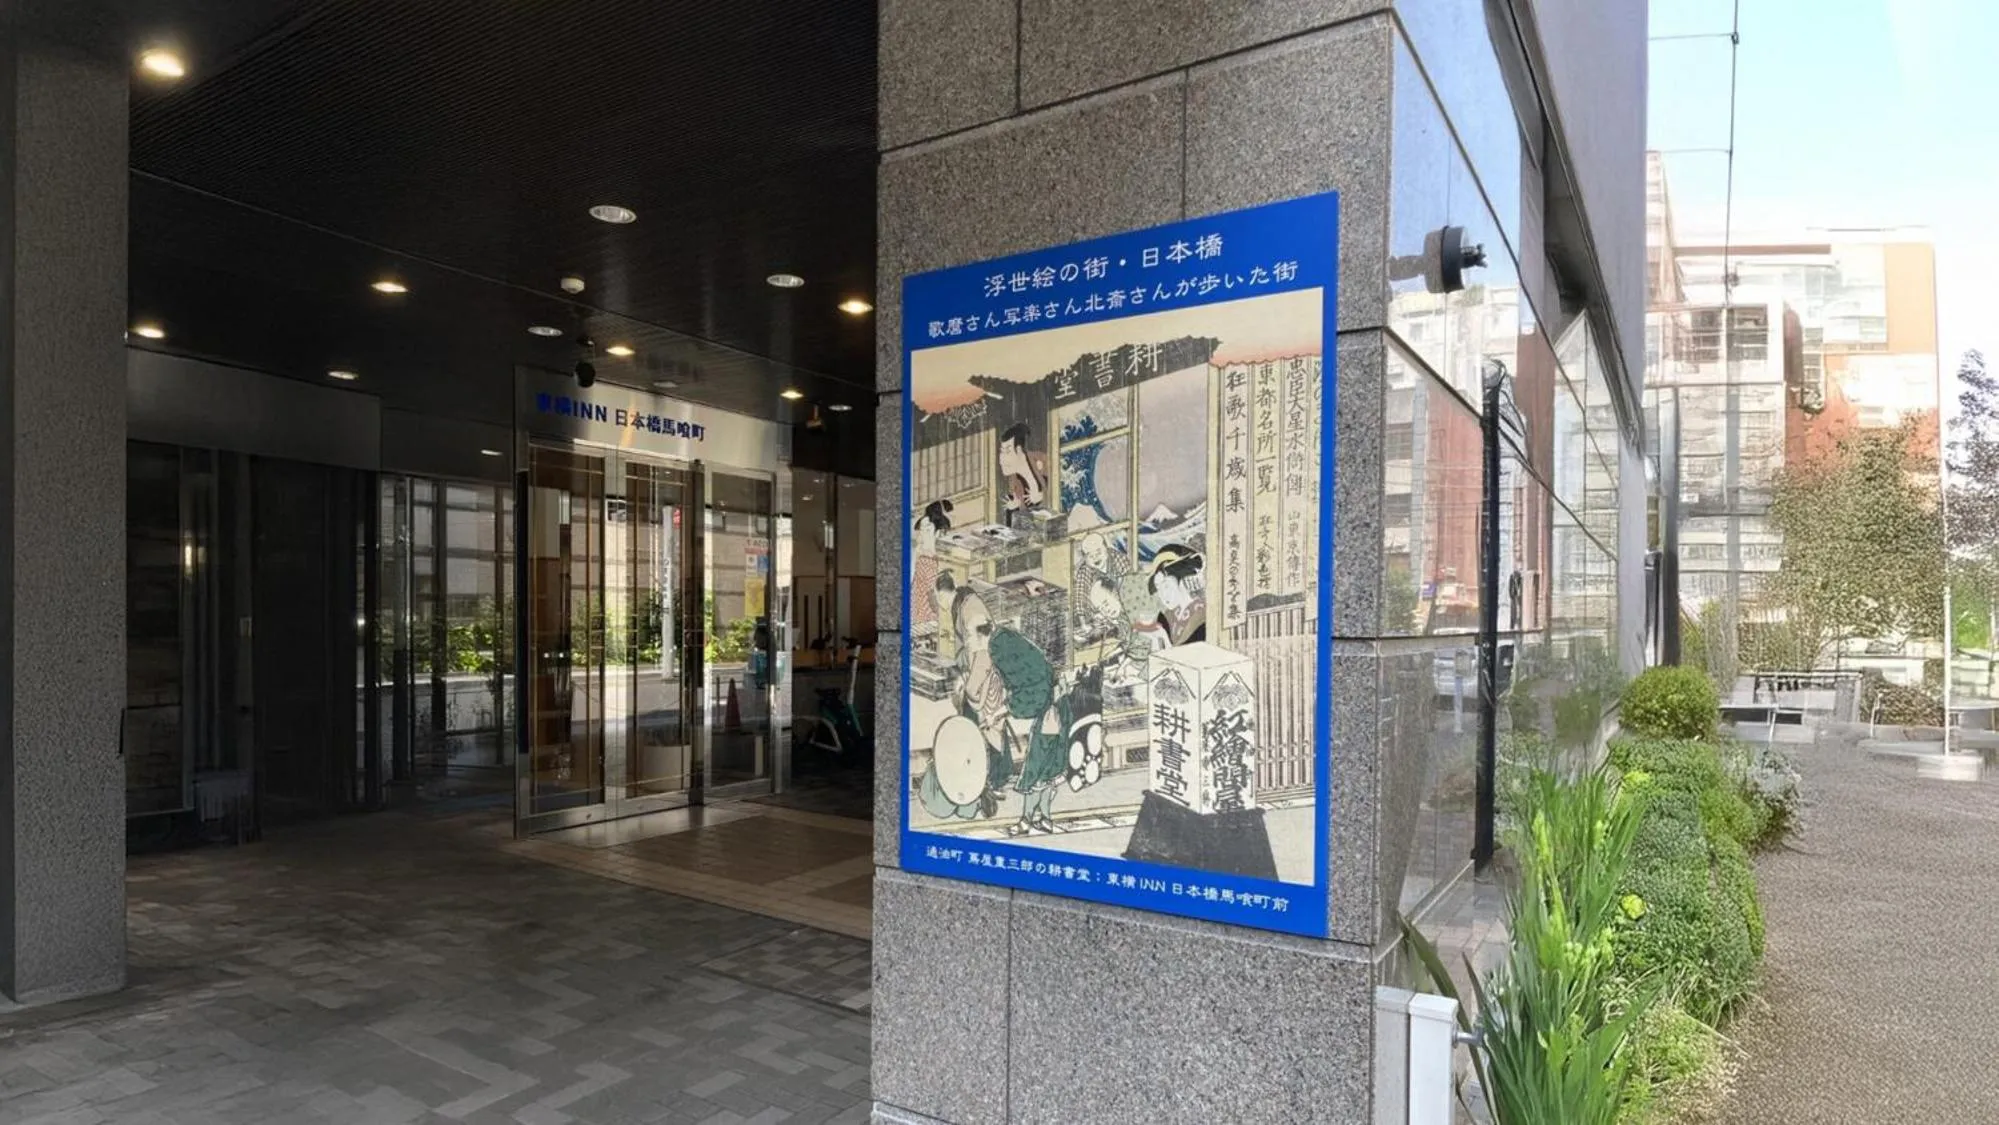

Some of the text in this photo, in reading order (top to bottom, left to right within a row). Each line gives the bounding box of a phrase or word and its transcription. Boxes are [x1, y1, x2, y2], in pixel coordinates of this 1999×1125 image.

[984, 233, 1224, 297] 浮世絵の街・日本橋
[536, 393, 705, 441] INN 日本橋馬喰町
[1153, 703, 1191, 806] 耕書堂
